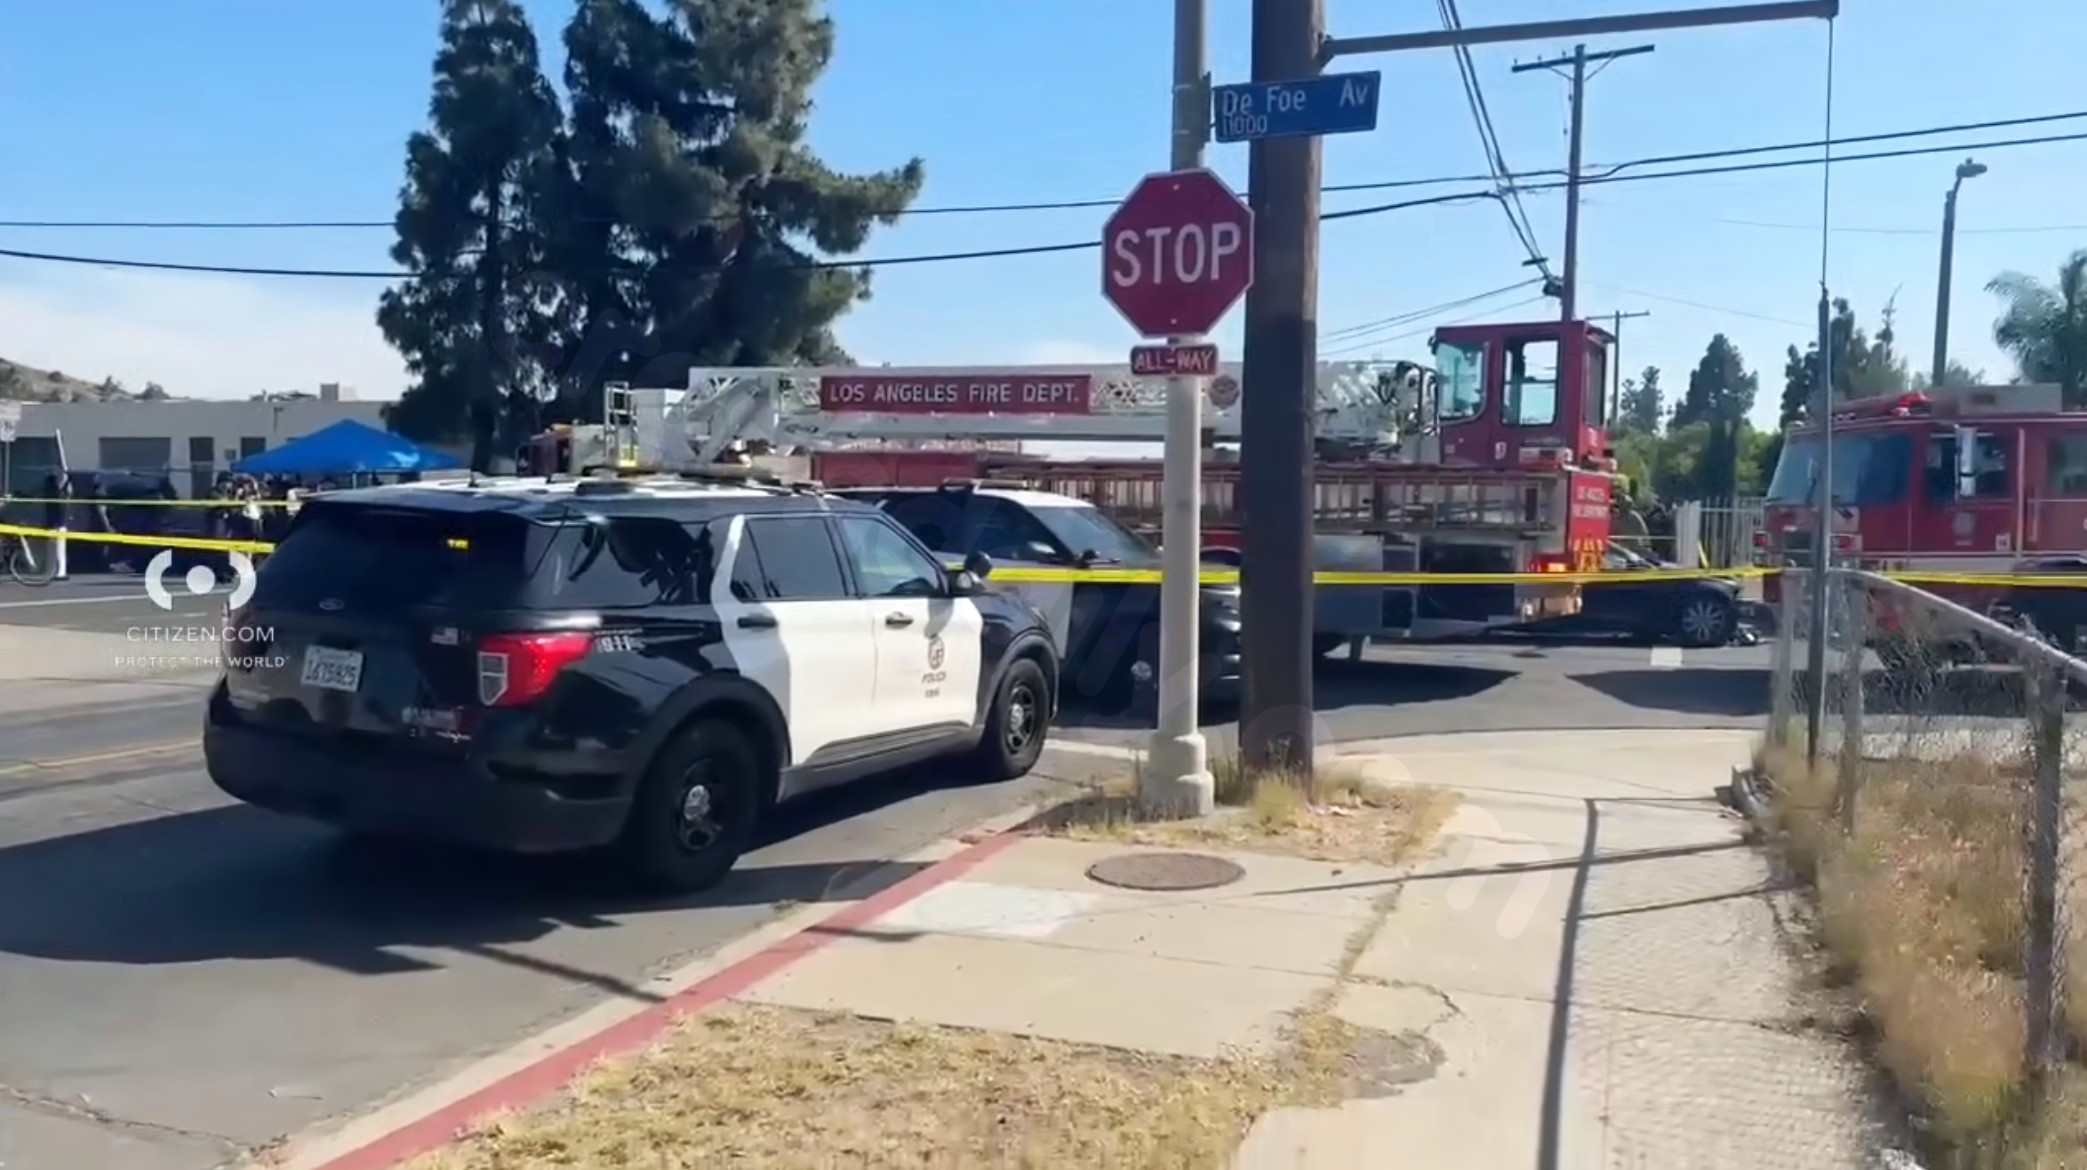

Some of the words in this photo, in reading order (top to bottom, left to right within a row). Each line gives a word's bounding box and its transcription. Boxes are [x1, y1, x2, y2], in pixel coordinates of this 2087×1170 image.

[1223, 90, 1253, 117] De
[1267, 86, 1307, 113] Foe
[1339, 79, 1369, 107] Av
[1223, 114, 1268, 136] 11000
[1113, 221, 1241, 287] STOP
[1134, 350, 1213, 371] ALL-WAY
[830, 384, 865, 402] LOS
[874, 383, 958, 402] ANGELES
[969, 383, 1011, 402] FIRE
[1023, 383, 1079, 402] DEPT.
